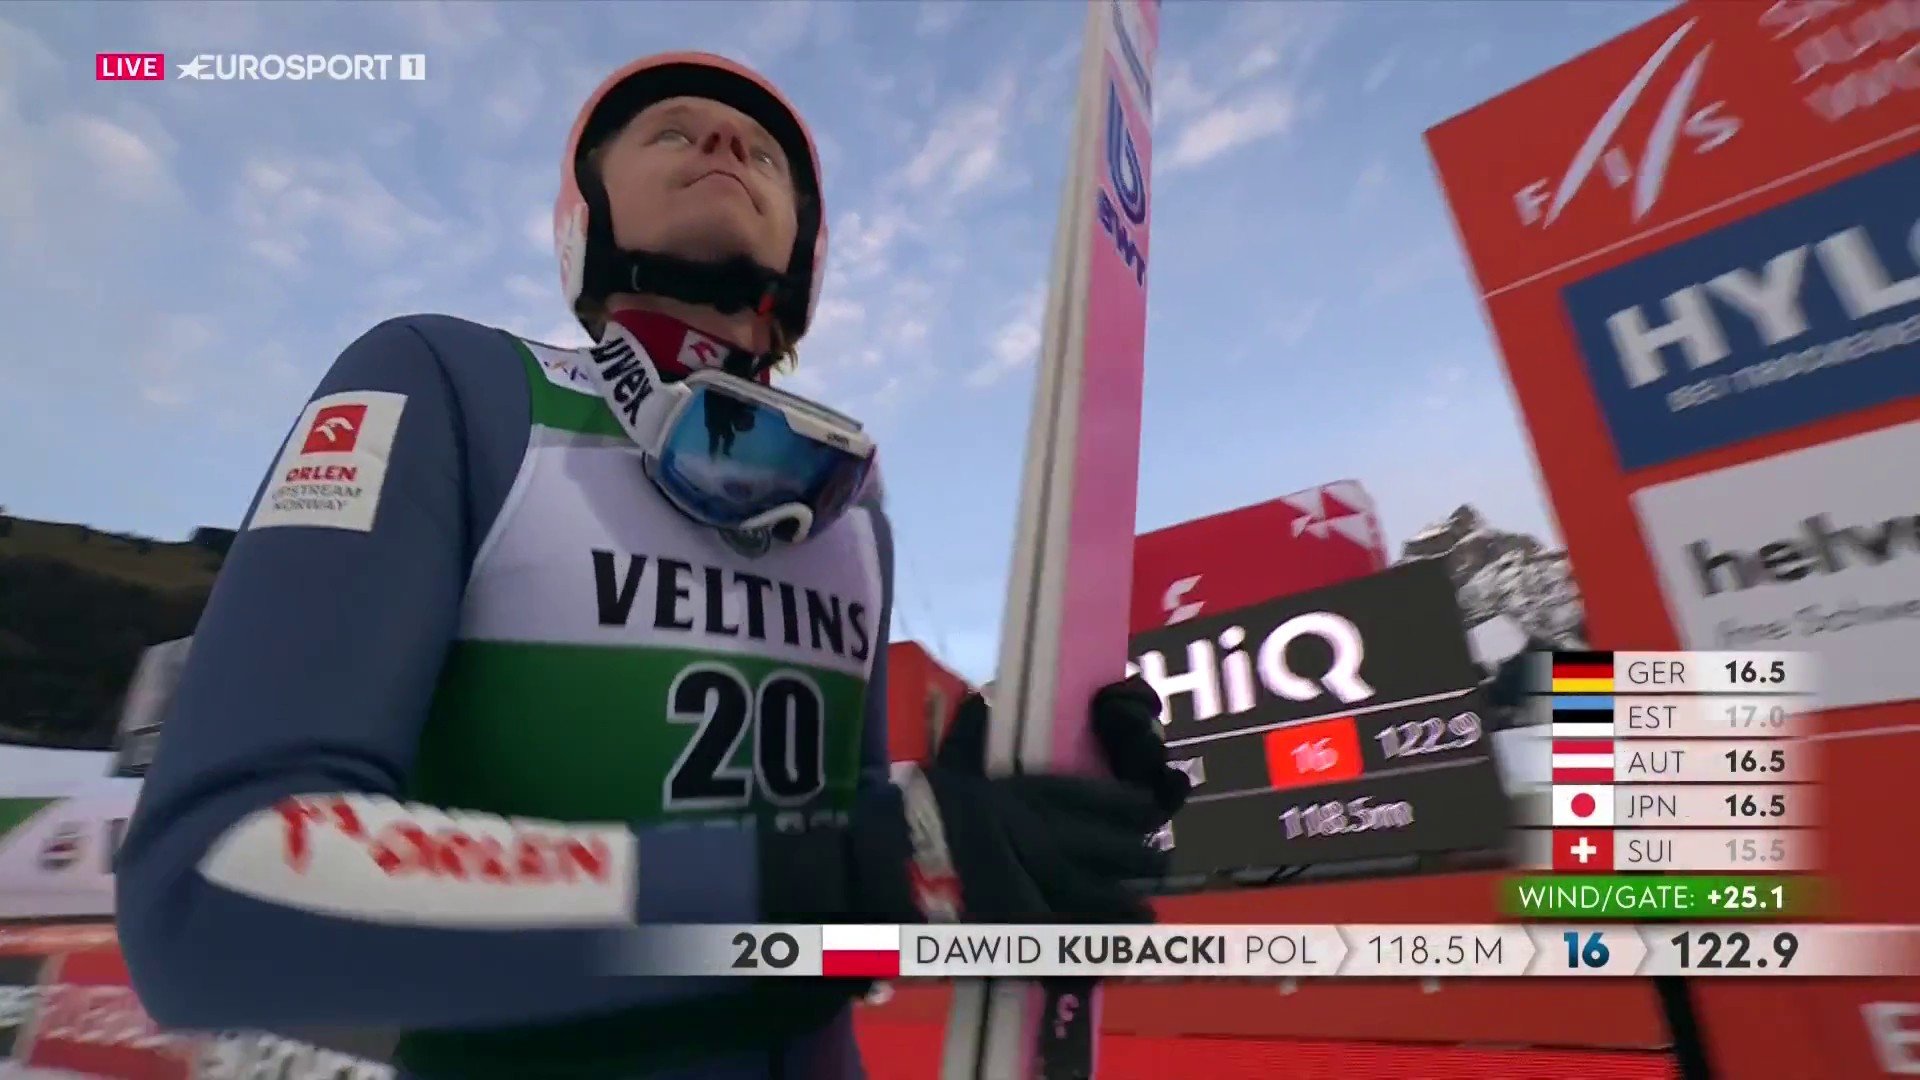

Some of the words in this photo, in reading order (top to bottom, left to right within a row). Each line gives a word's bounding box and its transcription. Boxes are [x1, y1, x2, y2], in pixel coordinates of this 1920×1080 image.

[1604, 224, 1920, 390] HYL
[590, 336, 654, 427] uvex
[284, 463, 358, 482] ORLEN
[591, 548, 870, 661] VELTINS
[1126, 610, 1375, 727] HiQ
[662, 661, 825, 811] 20
